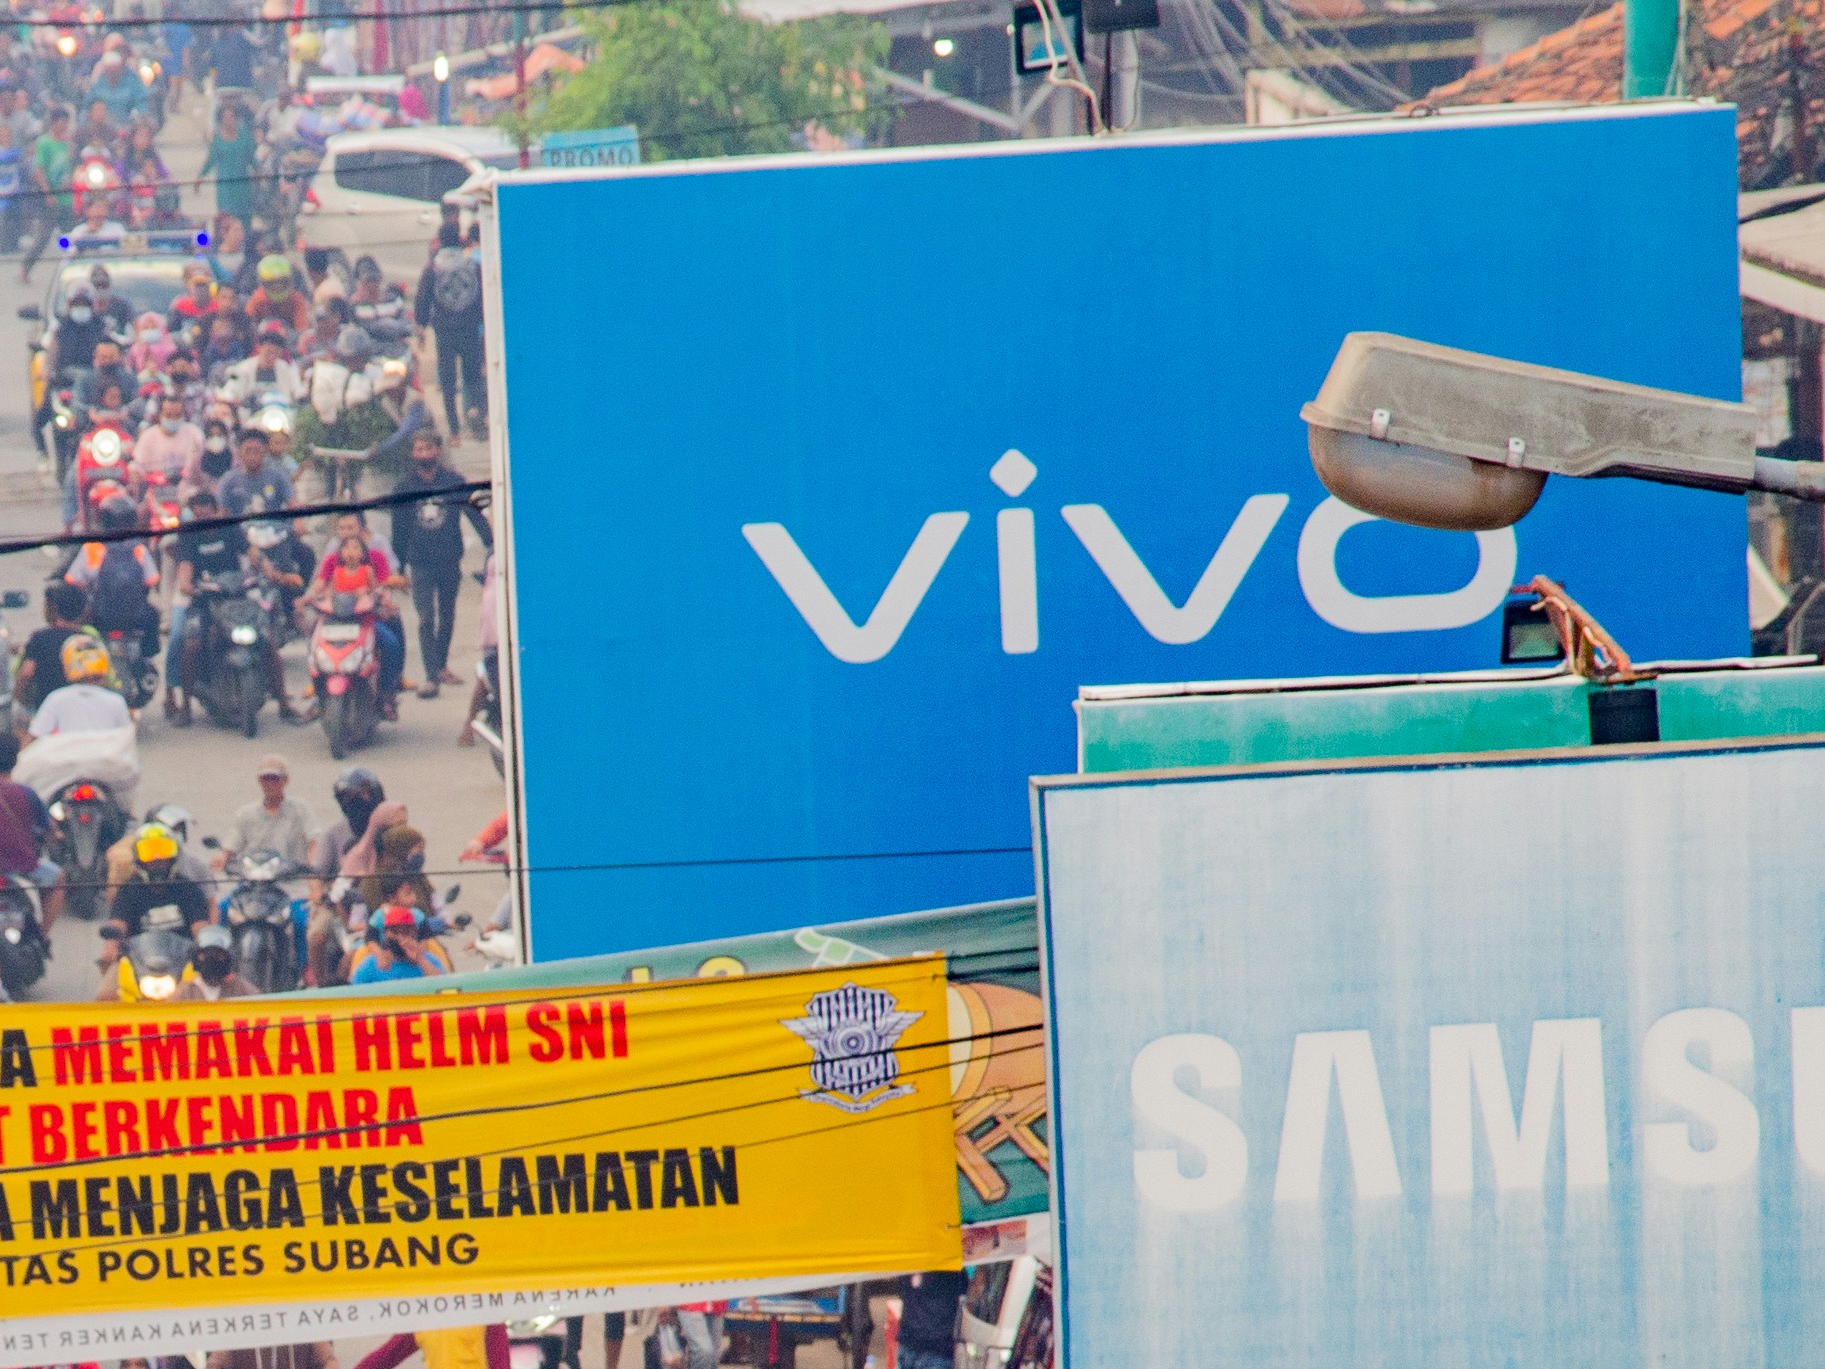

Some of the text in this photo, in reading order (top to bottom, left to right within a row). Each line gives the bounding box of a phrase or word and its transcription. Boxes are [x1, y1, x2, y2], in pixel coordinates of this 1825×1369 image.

[740, 448, 1519, 665] vivo
[50, 1013, 334, 1086] MEMAKAI
[354, 1004, 509, 1071] HELM
[527, 999, 628, 1063] SNI
[29, 1086, 424, 1165] BERKENDARA
[31, 1167, 304, 1240] MENJAGA
[321, 1145, 739, 1227] KESELAMATAN
[98, 1245, 265, 1283] POLRES
[284, 1231, 479, 1273] SUBANG
